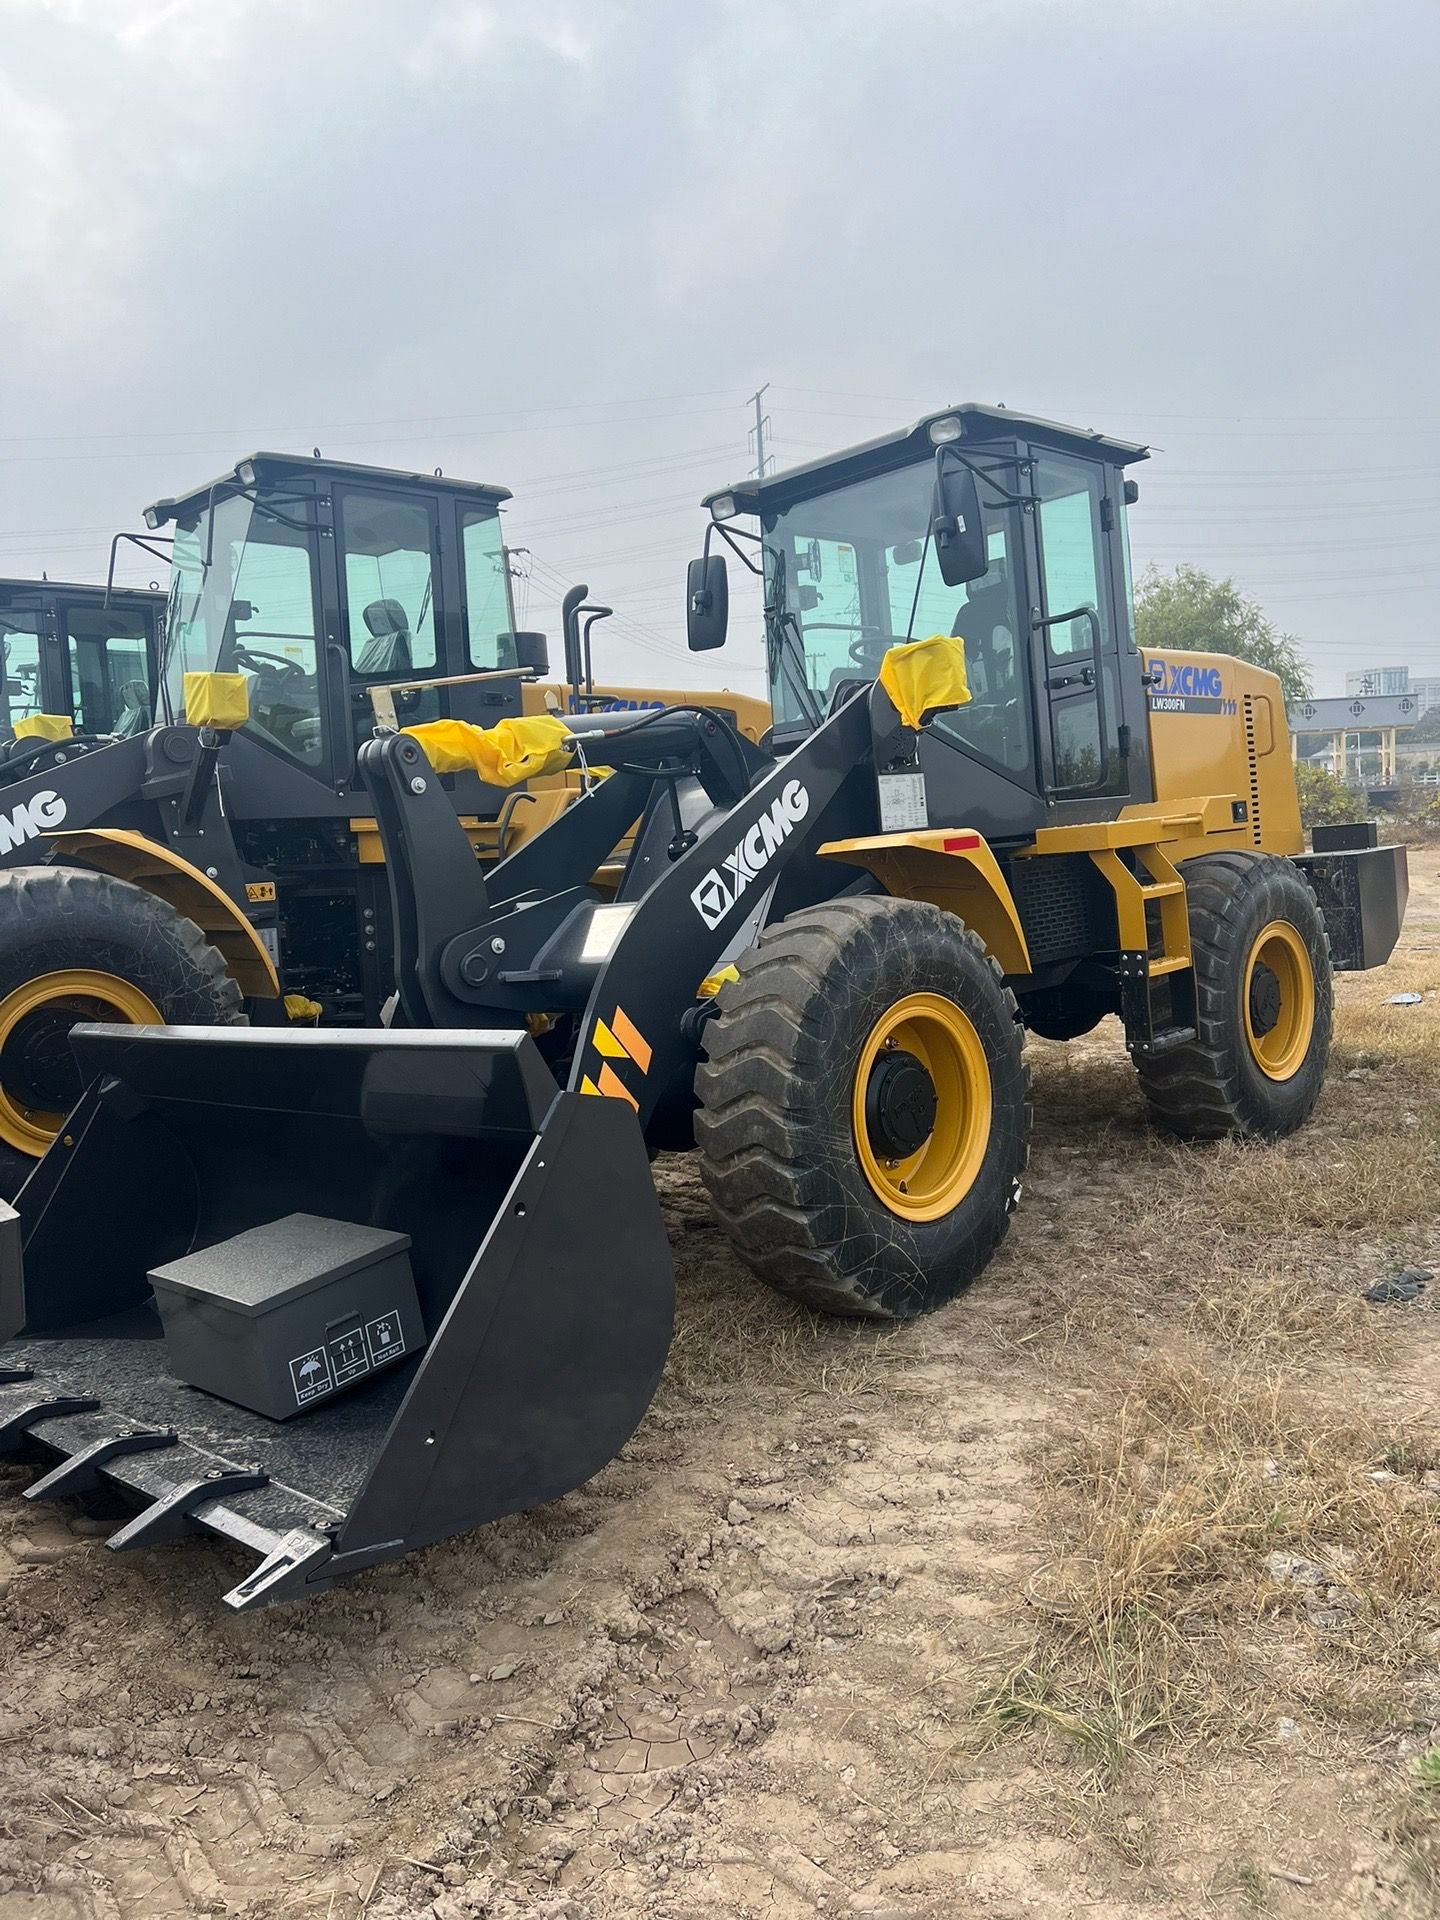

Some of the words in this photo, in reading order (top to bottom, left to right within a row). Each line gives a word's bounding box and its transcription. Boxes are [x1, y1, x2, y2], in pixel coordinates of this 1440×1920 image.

[1169, 666, 1222, 697] XCMG
[1152, 698, 1185, 710] LW300FN
[721, 779, 809, 901] XCMG
[300, 1389, 315, 1400] Keep
[316, 1382, 329, 1391] Dry
